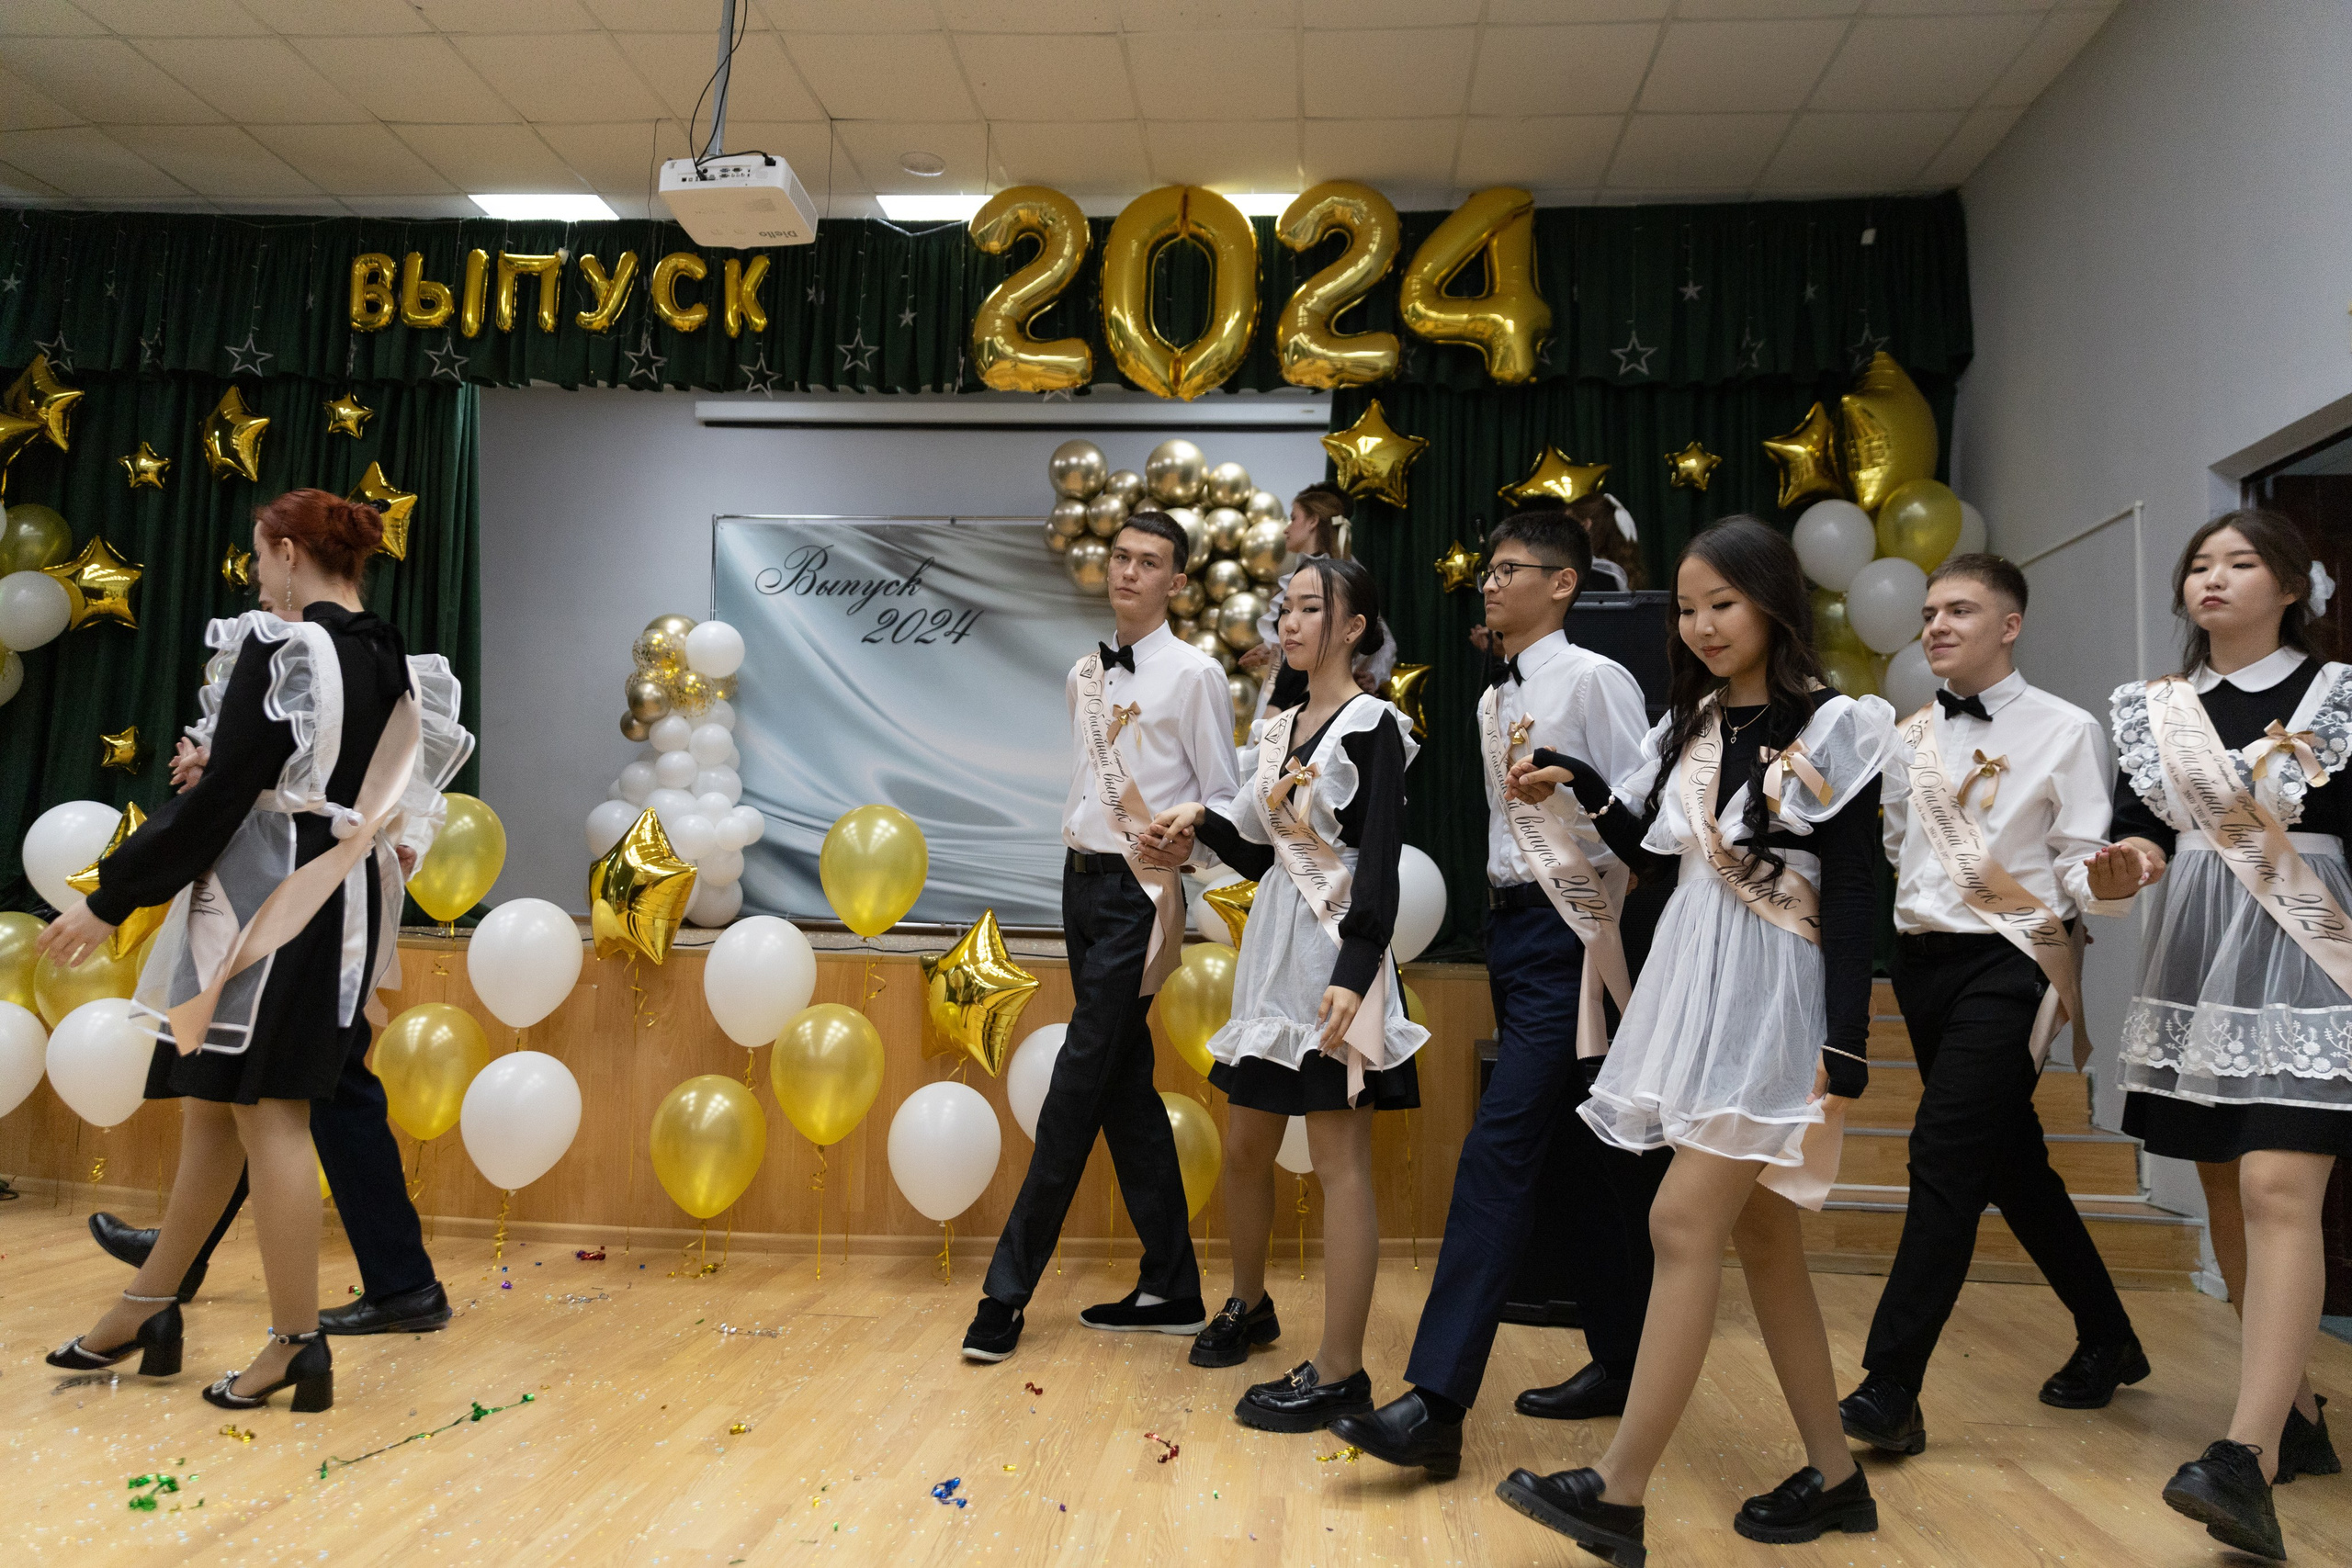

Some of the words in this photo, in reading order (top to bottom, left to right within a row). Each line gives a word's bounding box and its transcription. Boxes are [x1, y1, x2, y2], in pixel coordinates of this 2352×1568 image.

[350, 248, 771, 339] ВЫПУСК
[968, 183, 1551, 401] 2024
[755, 544, 935, 615] Выпуск
[861, 608, 985, 644] 2024
[1549, 874, 1615, 923] 2024
[2270, 893, 2352, 945] 2024
[1995, 907, 2067, 948] 2024
